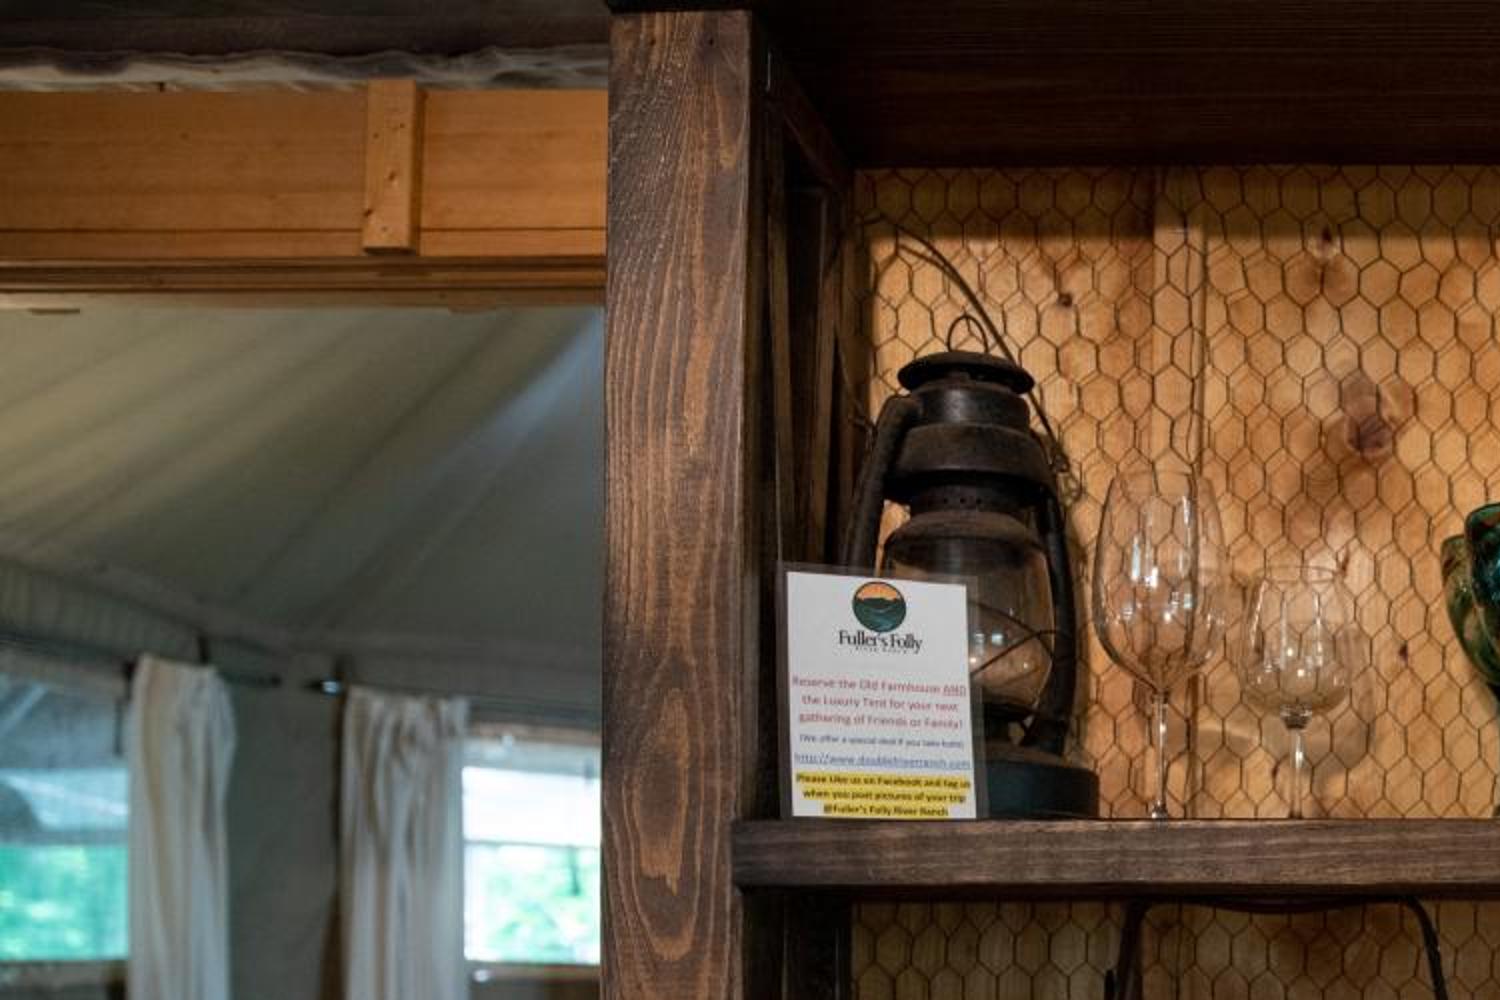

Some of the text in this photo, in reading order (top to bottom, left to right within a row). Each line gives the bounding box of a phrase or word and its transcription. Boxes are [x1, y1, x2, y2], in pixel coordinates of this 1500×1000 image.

[839, 629, 889, 647] Fuller's
[890, 633, 923, 654] Folly
[838, 678, 857, 689] the
[859, 679, 878, 690] Old
[943, 684, 967, 696] AND
[801, 696, 959, 711] the Luxury Tent for your next
[799, 713, 851, 727] gathering
[853, 715, 865, 725] of
[867, 716, 907, 727] Friends
[910, 719, 921, 727] or
[796, 774, 827, 784] Please
[877, 777, 921, 787] Facebook
[923, 779, 940, 787] and
[943, 779, 959, 789] tag
[803, 789, 966, 804] when you post pictures of your trip
[869, 805, 891, 816] Folly
[894, 805, 917, 814] River
[919, 806, 949, 816] Ranch
